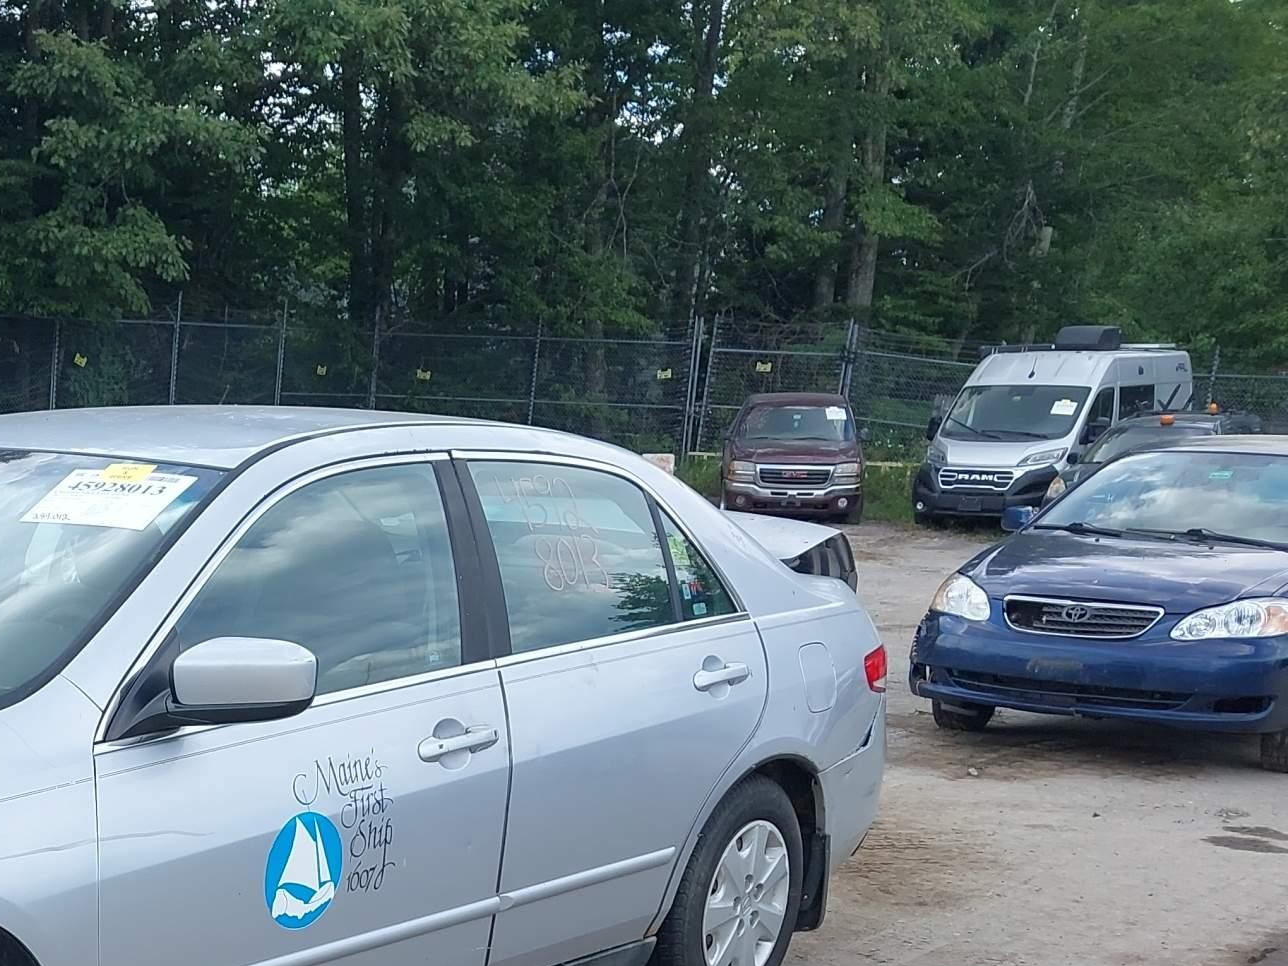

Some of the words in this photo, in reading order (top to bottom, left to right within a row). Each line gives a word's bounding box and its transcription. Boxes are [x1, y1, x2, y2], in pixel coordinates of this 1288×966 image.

[67, 480, 167, 496] 45928013
[958, 473, 995, 482] RAM
[535, 534, 609, 591] 8013
[293, 747, 388, 805] Maine's
[341, 782, 394, 828] First
[349, 816, 396, 889] Ship
[347, 861, 377, 893] 1607
